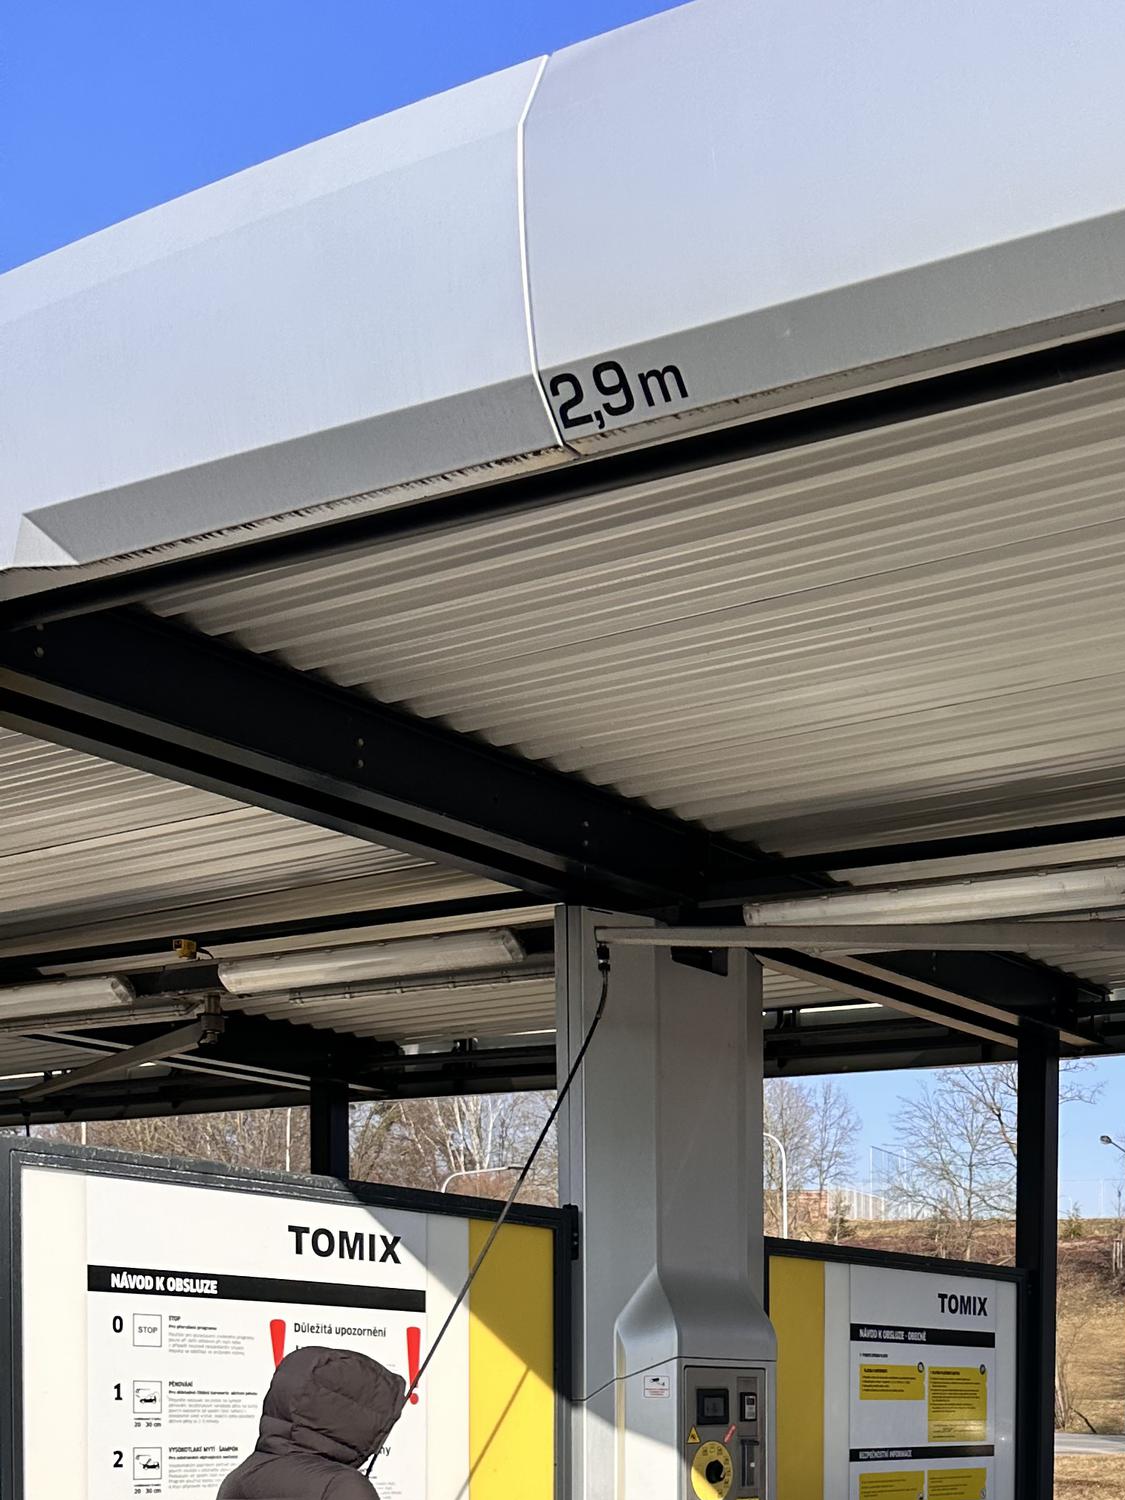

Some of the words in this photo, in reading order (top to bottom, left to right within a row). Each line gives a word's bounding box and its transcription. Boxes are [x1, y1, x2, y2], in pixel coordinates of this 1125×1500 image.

[288, 1225, 402, 1264] TOMIX
[111, 1271, 154, 1290] NÁVOD
[155, 1275, 166, 1291] K
[167, 1276, 218, 1294] OBSLUZE
[938, 1293, 988, 1316] TOMIX
[112, 1315, 123, 1333] 0
[138, 1325, 158, 1334] STOP
[294, 1322, 332, 1335] Důležitá
[335, 1326, 387, 1338] upozornění
[113, 1383, 122, 1400] 1
[113, 1451, 123, 1468] 2
